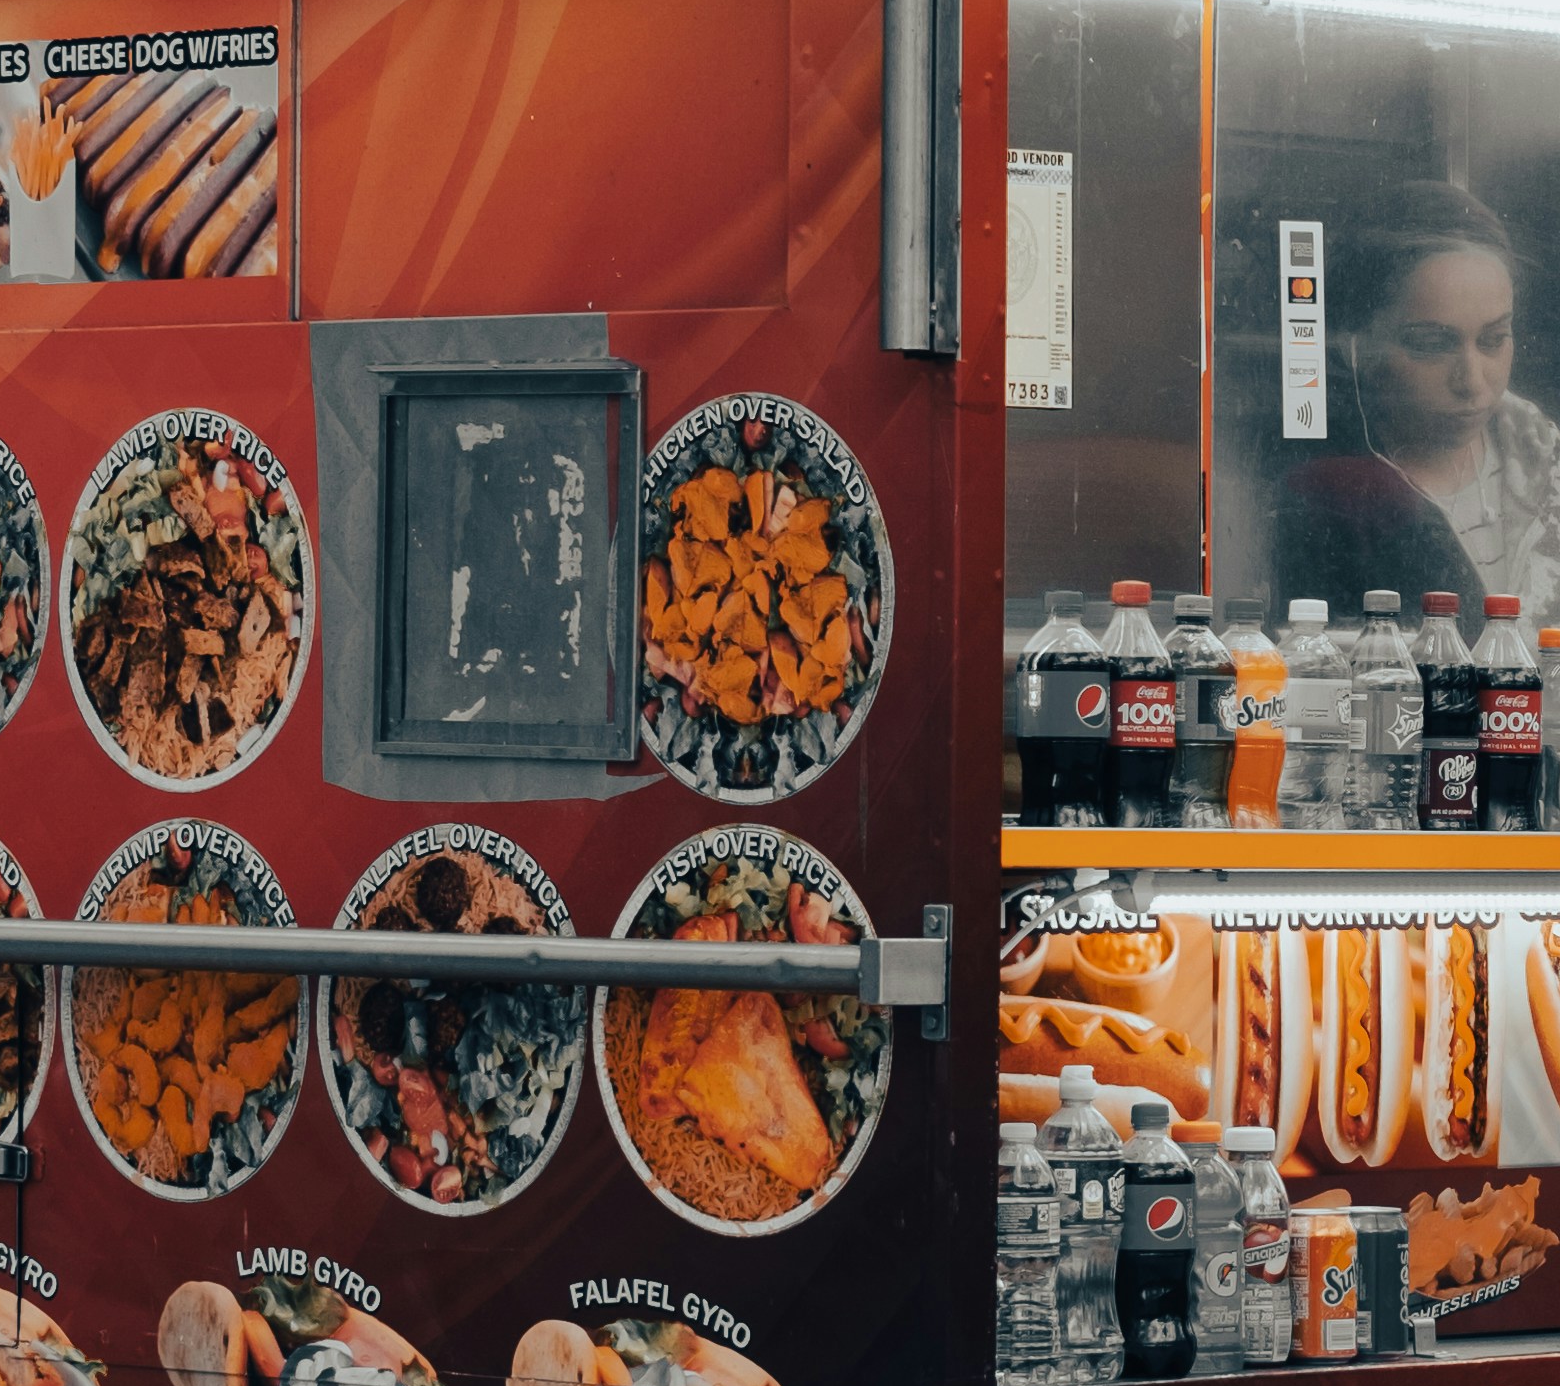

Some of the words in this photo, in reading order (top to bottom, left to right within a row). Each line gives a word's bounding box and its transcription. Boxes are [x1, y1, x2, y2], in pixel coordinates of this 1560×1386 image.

[1023, 152, 1064, 166] VENDOR
[1292, 326, 1314, 337] VISA
[92, 421, 157, 491] LAMB
[162, 413, 227, 443] OVER
[231, 426, 287, 489] RICE
[729, 398, 792, 428] OVER
[796, 415, 866, 504] SALAD
[1118, 703, 1174, 724] 100%
[1395, 716, 1423, 736] Spri
[1481, 712, 1539, 732] 100%
[652, 839, 709, 894] FISH
[712, 831, 777, 861] OVER
[782, 844, 839, 899] RICE
[236, 1247, 307, 1276] LAMB
[314, 1256, 380, 1311] GYRO
[1205, 1251, 1237, 1297] G
[1473, 1275, 1521, 1304] FRIES
[569, 1277, 675, 1312] FALAFEL
[682, 1292, 751, 1349] GYRO
